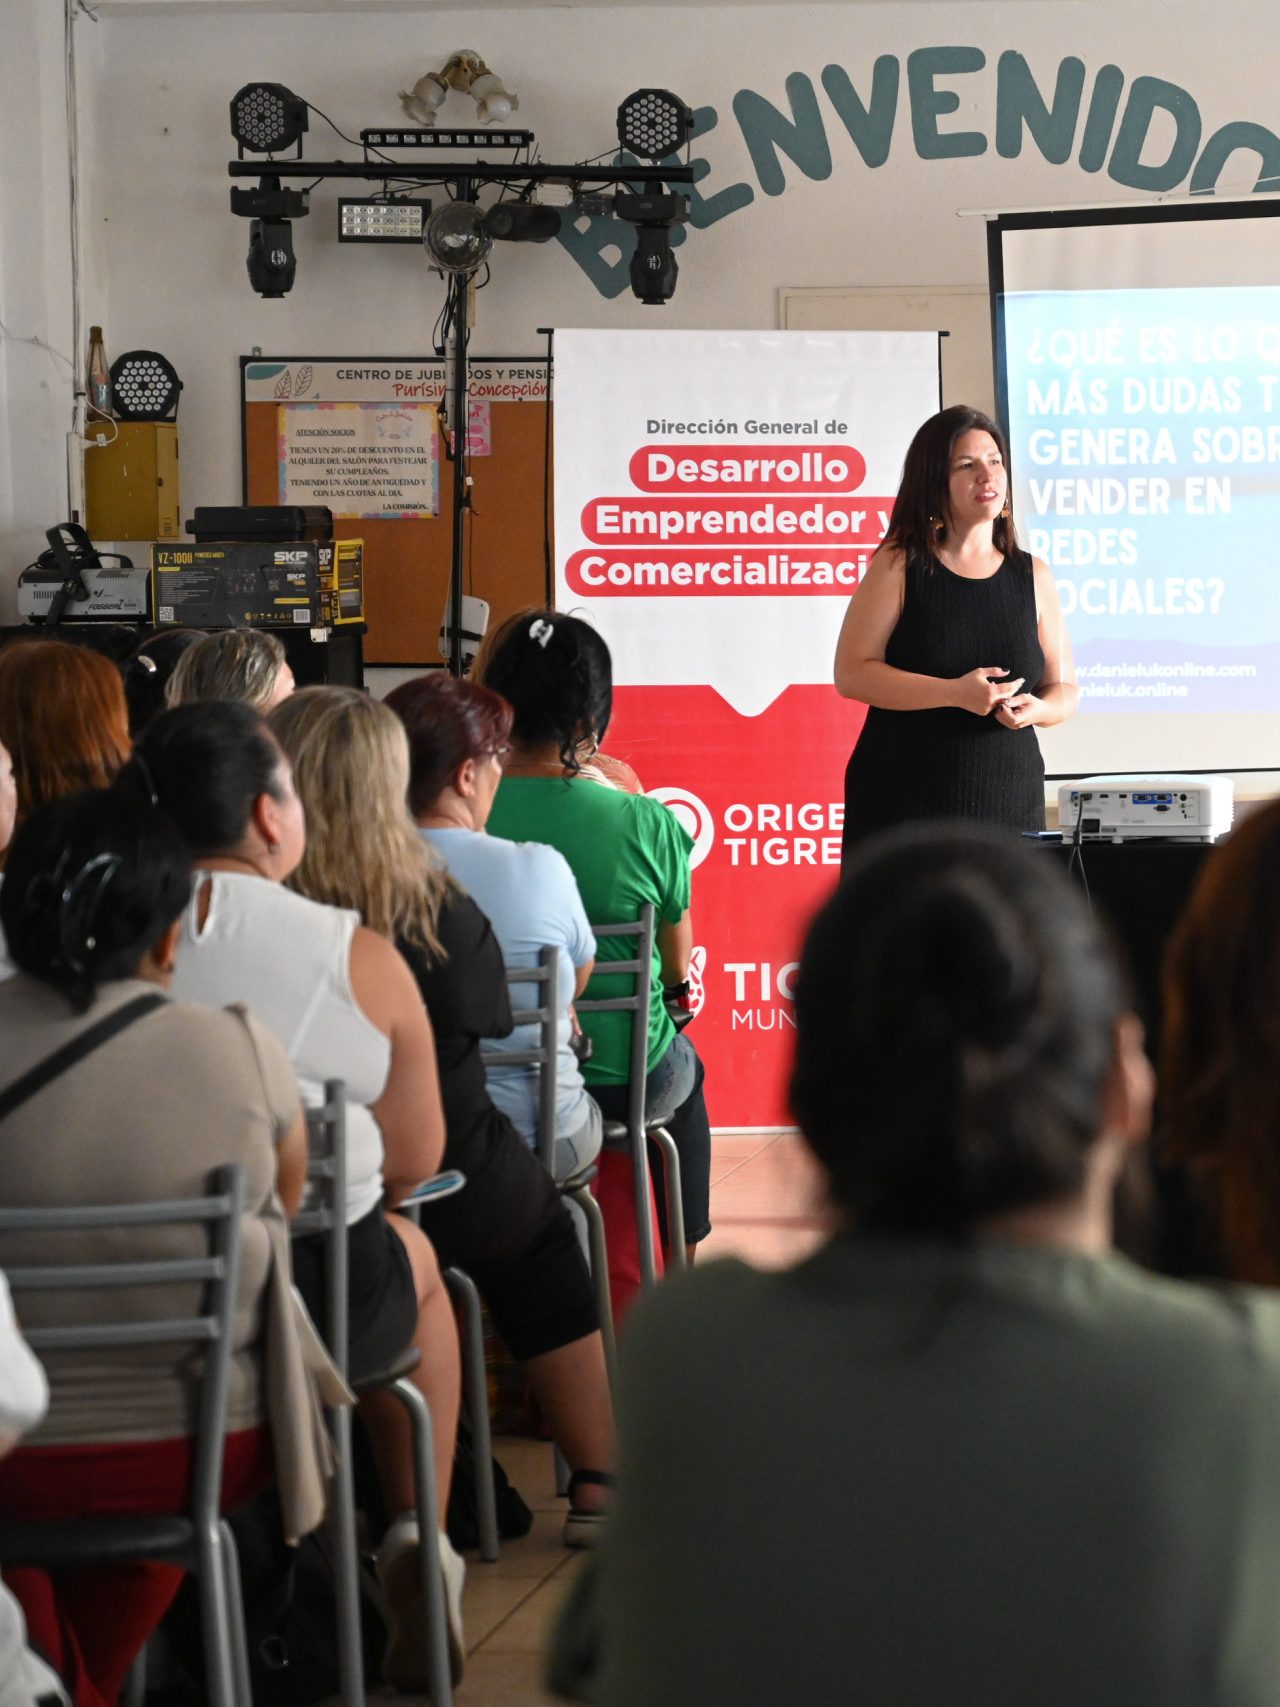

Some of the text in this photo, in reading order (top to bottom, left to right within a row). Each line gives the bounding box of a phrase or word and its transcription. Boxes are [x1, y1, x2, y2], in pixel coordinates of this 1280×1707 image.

[1027, 319, 1124, 367] ¿QUÉ
[1138, 327, 1178, 364] ES
[1194, 325, 1238, 364] LO
[336, 370, 391, 380] CENTRO
[395, 370, 412, 379] DE
[417, 369, 491, 379] JUBIDOS
[496, 369, 504, 379] Y
[468, 381, 547, 399] Concepción
[1027, 370, 1108, 416] MÁS
[1123, 375, 1242, 415] DUDAS
[330, 428, 356, 436] SOCIOS
[646, 419, 848, 435] Dirección General de
[359, 446, 403, 454] DESCUENTO
[1028, 428, 1177, 466] GENERA
[289, 457, 326, 465] ALQUILER
[389, 457, 427, 465] FESTEJAR
[337, 466, 390, 475] CUMPLEAÑOS.
[647, 452, 849, 482] Desarrollo
[342, 477, 359, 486] AÑO
[346, 489, 376, 497] CUOTAS
[1028, 477, 1232, 516] VENDER EN
[596, 504, 866, 539] Emprendedor
[274, 551, 309, 562] SKP
[1029, 528, 1138, 566] REDES
[579, 555, 867, 586] Comercializaci
[1056, 577, 1225, 615] OCIALES?
[1075, 662, 1256, 678] w.danielukonline.com
[724, 803, 845, 832] ORIGE
[724, 837, 842, 865] TIGRE
